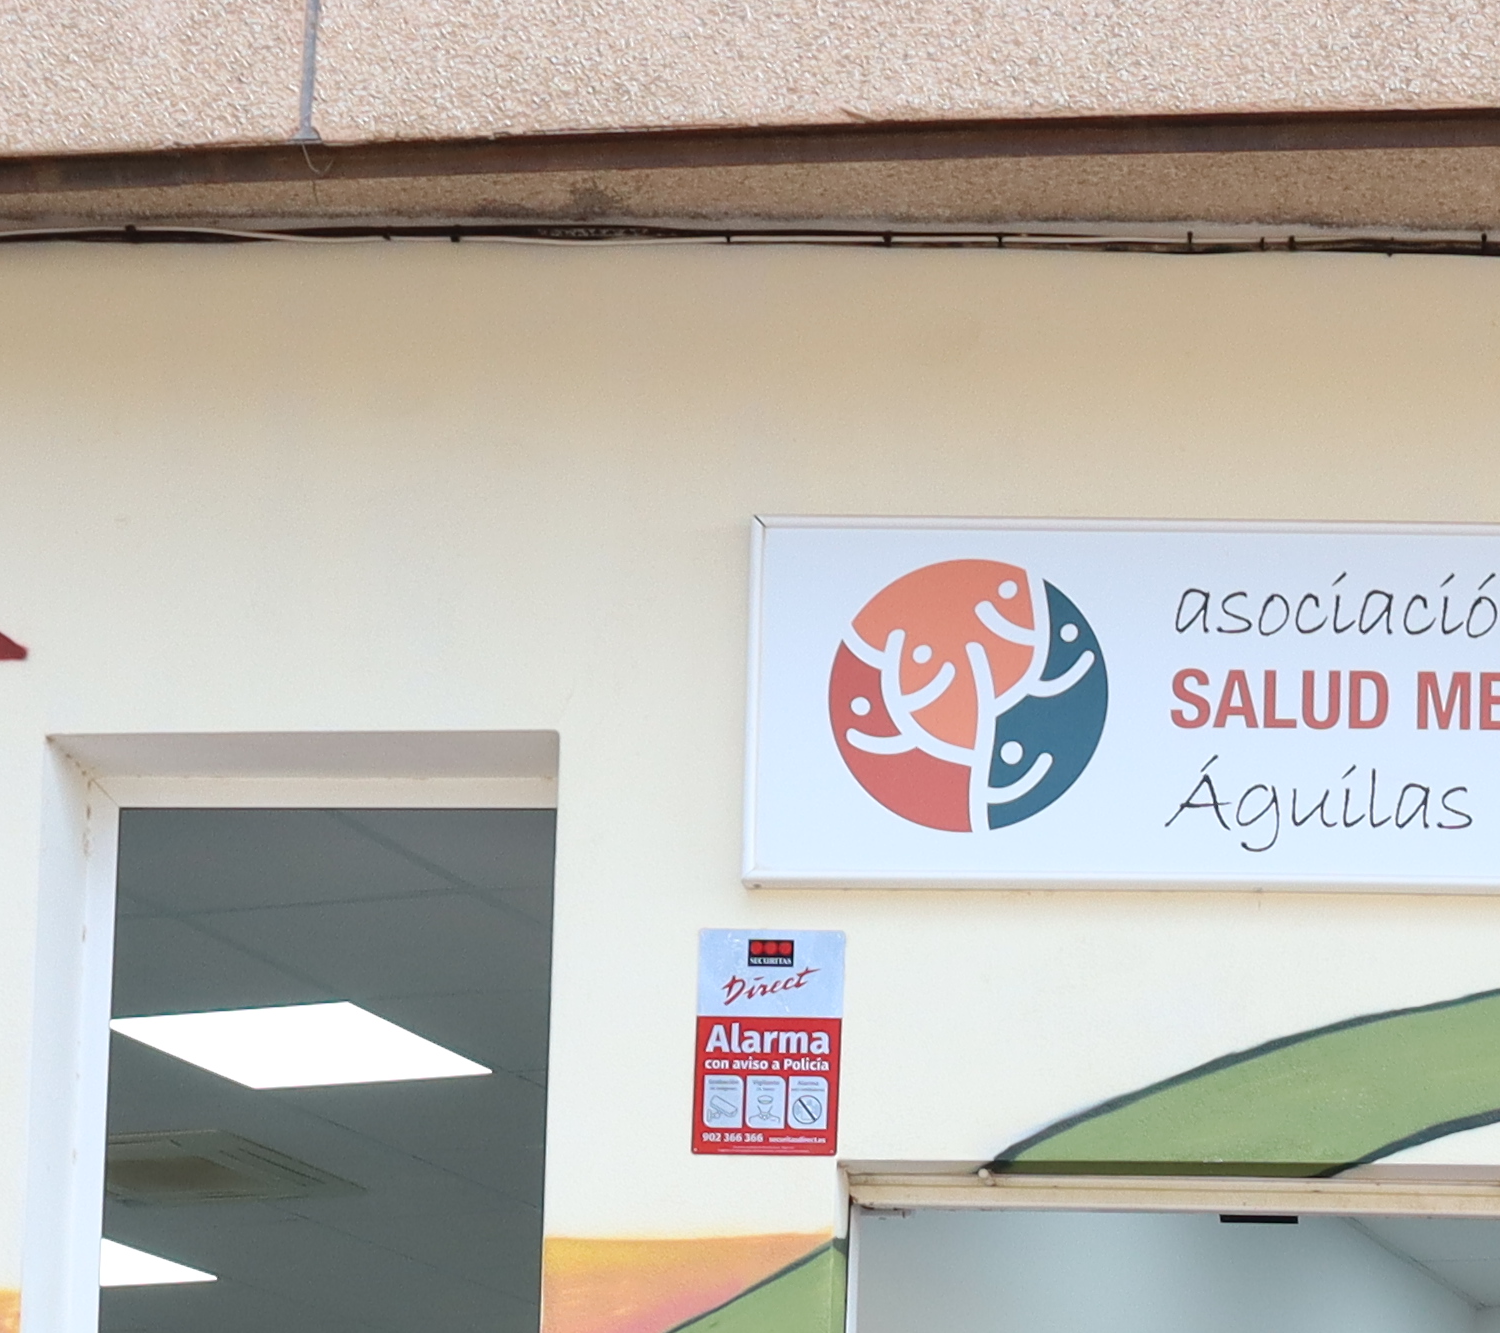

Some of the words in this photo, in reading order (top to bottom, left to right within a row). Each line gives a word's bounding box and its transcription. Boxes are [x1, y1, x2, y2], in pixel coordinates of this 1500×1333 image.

[1170, 667, 1390, 731] SALUD
[1165, 754, 1475, 853] Águilas
[749, 957, 792, 965] SECURITAS
[721, 967, 821, 1006] Direct
[705, 1022, 830, 1054] Alarma
[704, 1058, 729, 1070] con
[732, 1057, 768, 1070] aviso
[771, 1060, 780, 1070] a
[783, 1057, 830, 1071] Policía
[702, 1132, 721, 1142] 902
[723, 1133, 742, 1142] 366
[744, 1133, 763, 1143] 366
